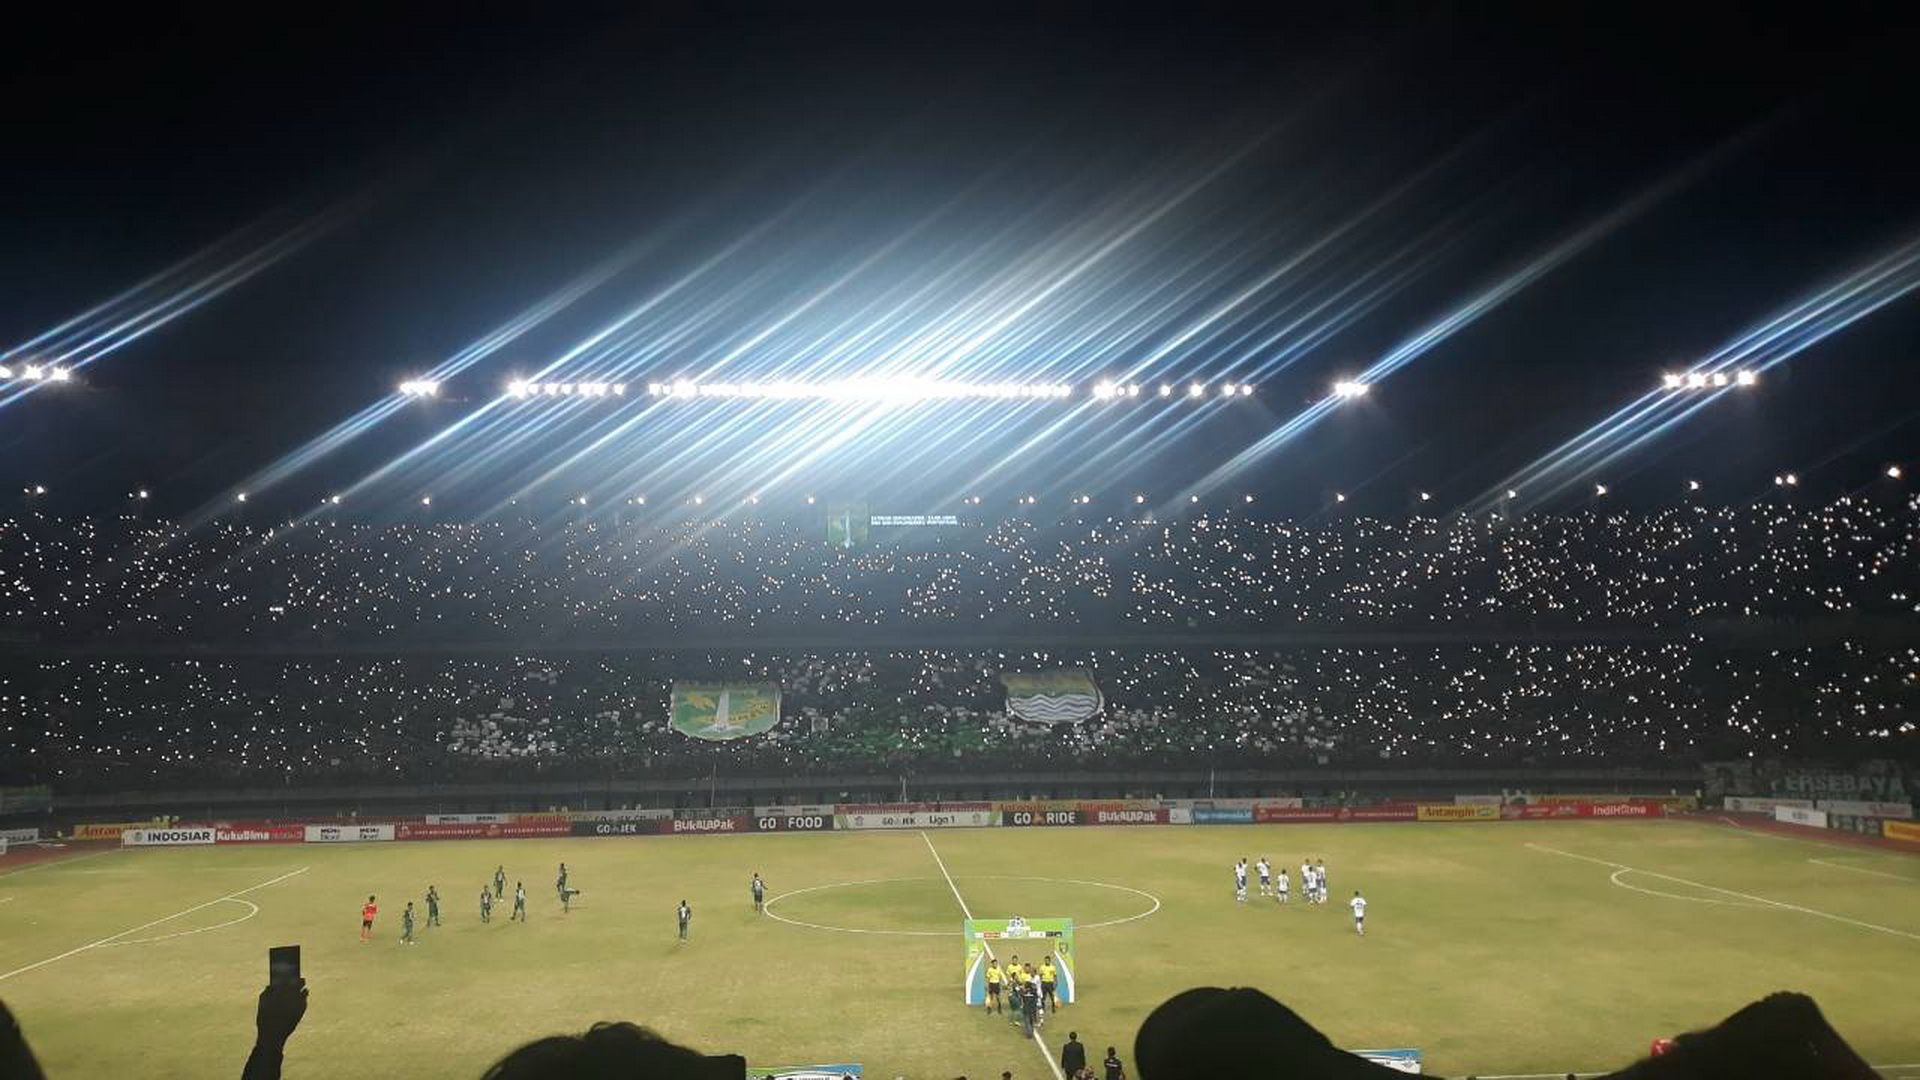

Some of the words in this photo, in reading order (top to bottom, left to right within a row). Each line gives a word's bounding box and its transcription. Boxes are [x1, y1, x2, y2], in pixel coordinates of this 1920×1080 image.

[759, 816, 776, 829] GO
[788, 816, 823, 829] FOOD
[1014, 812, 1031, 824] GO
[1046, 811, 1076, 823] RIDE
[147, 831, 210, 842] INDOSIAR
